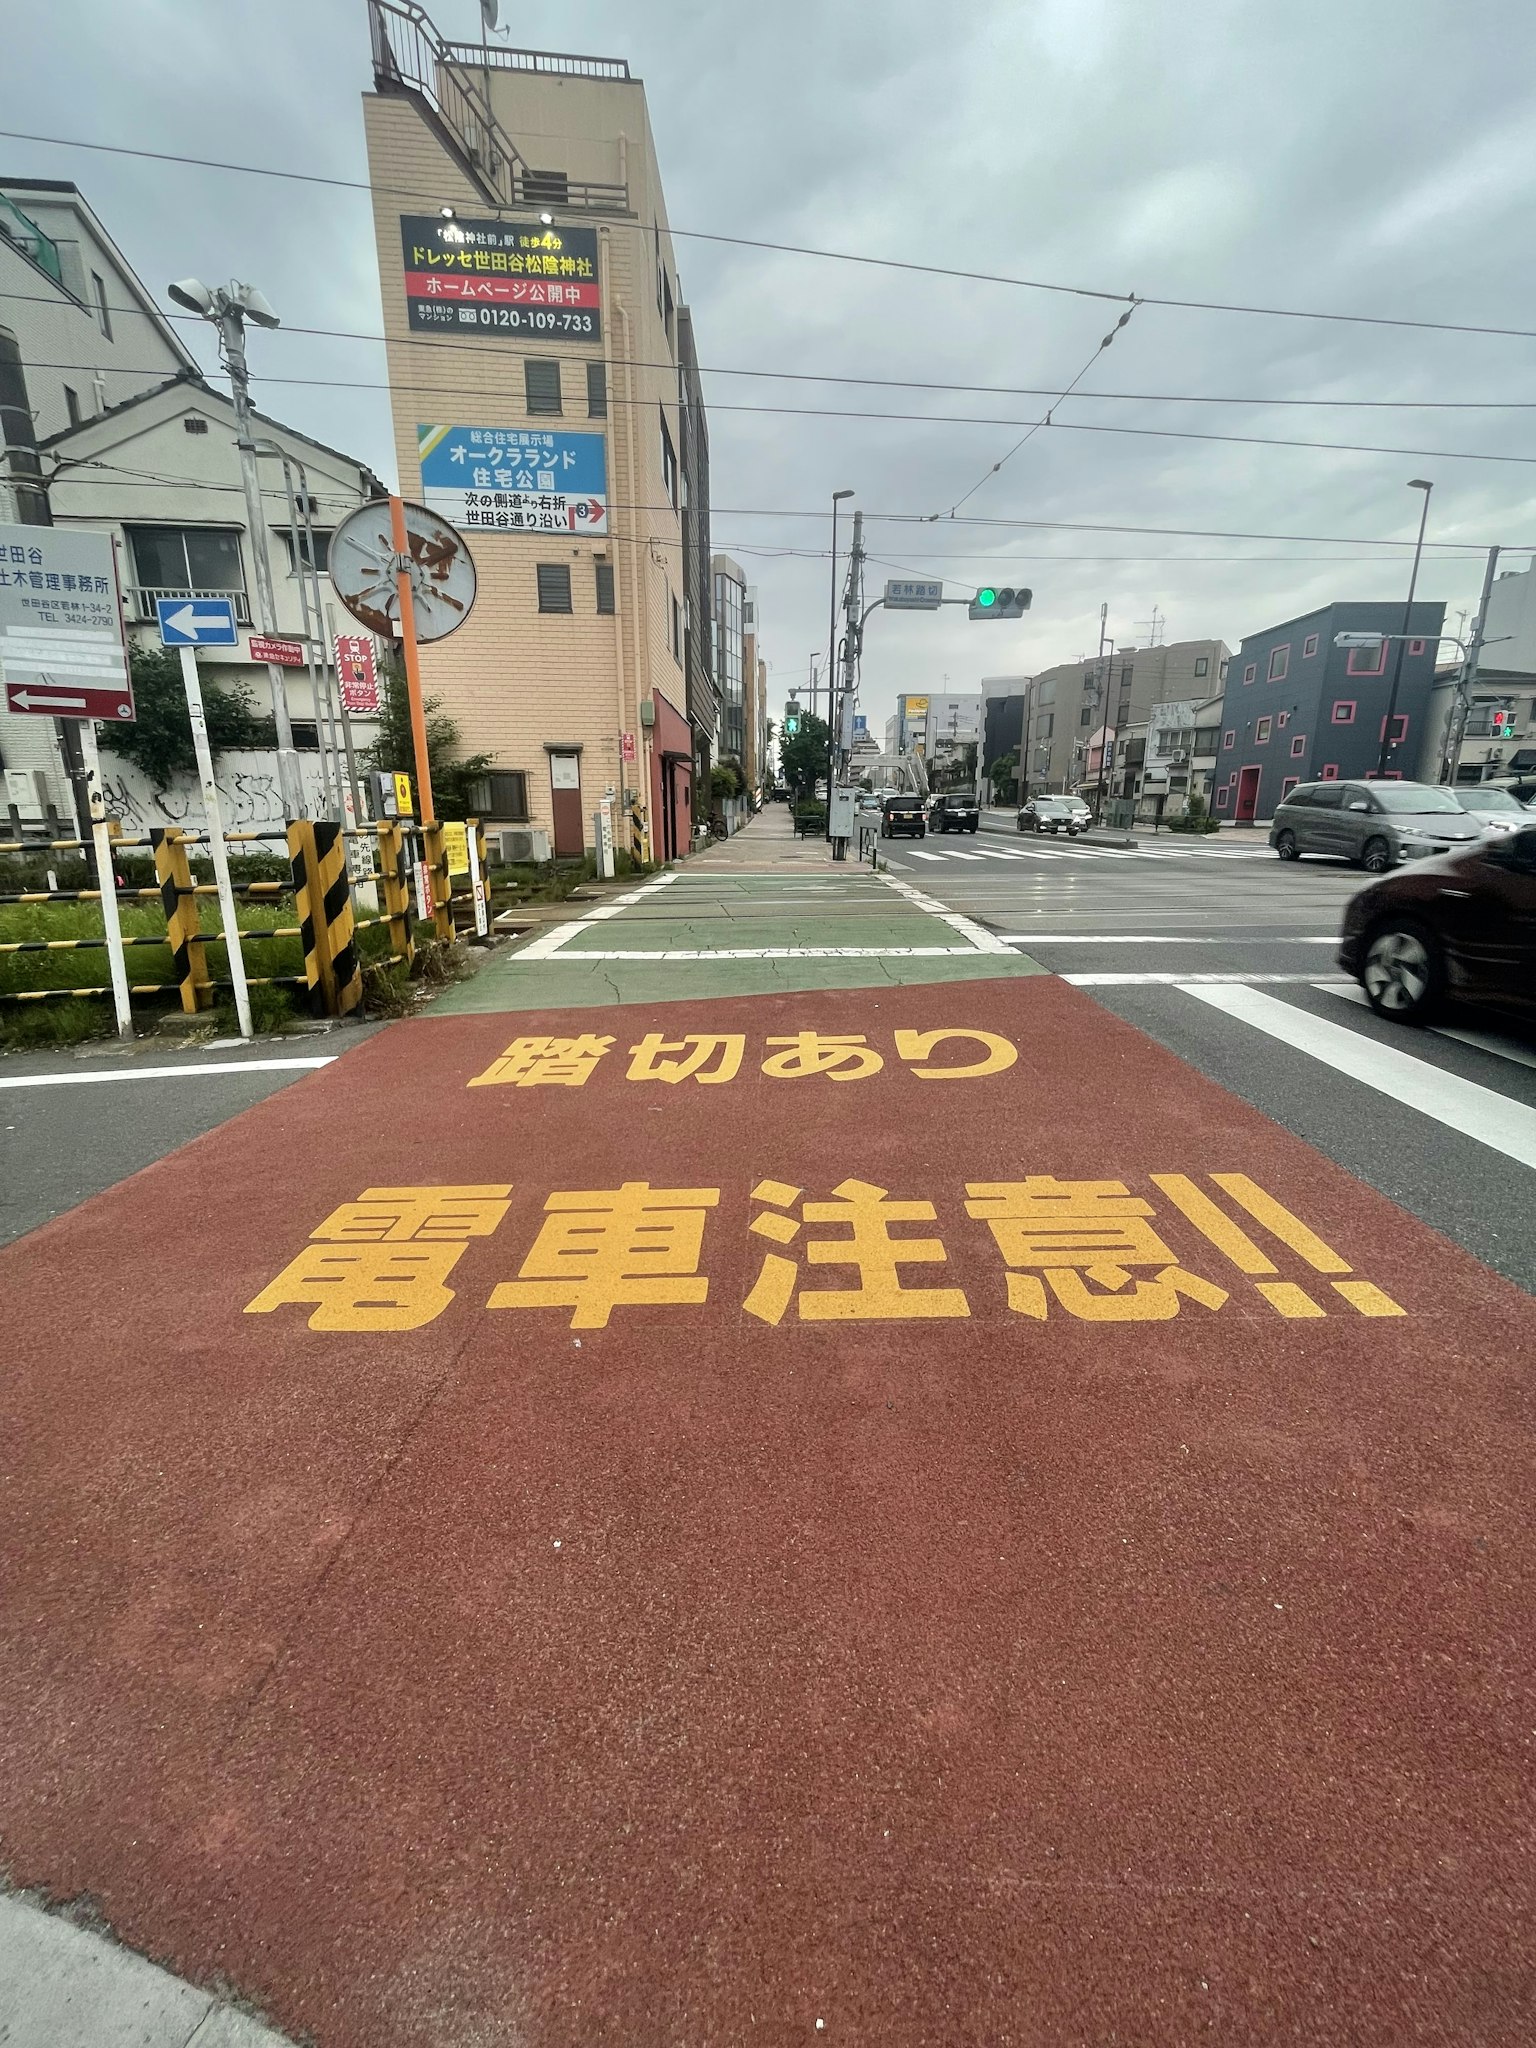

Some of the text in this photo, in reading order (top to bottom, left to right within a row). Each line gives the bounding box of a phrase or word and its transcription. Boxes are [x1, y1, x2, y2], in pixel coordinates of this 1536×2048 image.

[412, 247, 593, 277] ドレッセ世田谷松陰神社
[426, 277, 581, 304] ホームページ公開中
[480, 308, 592, 332] 0120-109-733
[470, 431, 553, 448] 総合住宅展示場
[450, 445, 576, 470] オークラランド
[473, 467, 555, 490] 住宅公園
[465, 491, 566, 511] 次の側道より右折
[578, 505, 586, 517] 3
[466, 510, 568, 528] 世田谷通り沿い
[38, 611, 114, 627] TEL 3424-2790
[344, 654, 367, 662] STOP
[349, 689, 371, 697] ボタン
[467, 1029, 1019, 1088] 踏切あり
[243, 1173, 1407, 1330] 電車注意!!
